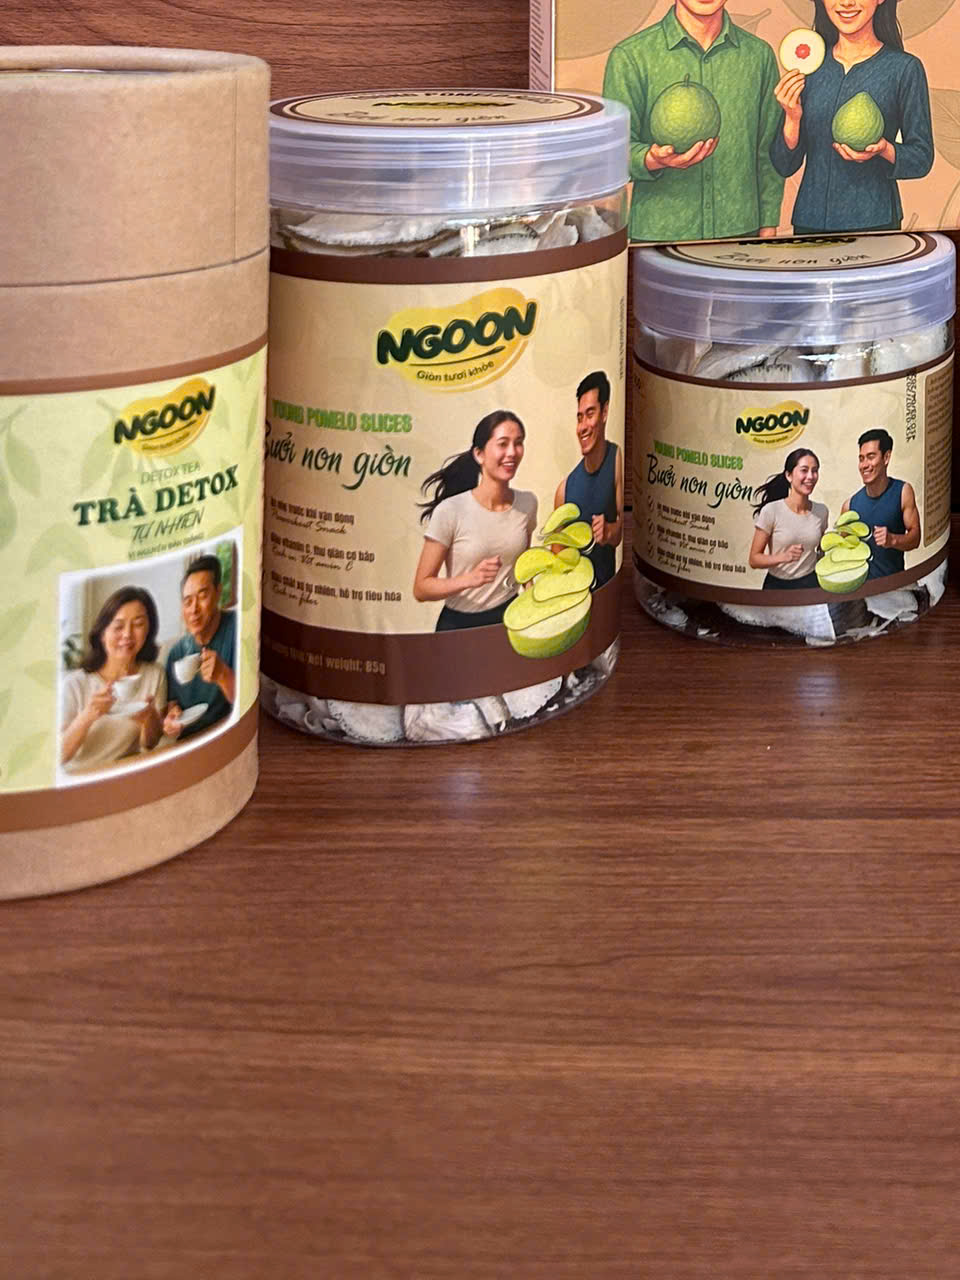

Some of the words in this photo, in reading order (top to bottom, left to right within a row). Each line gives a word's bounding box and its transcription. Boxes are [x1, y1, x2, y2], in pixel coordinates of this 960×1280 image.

[377, 301, 537, 364] NGOON
[416, 370, 442, 382] Giòn
[444, 369, 467, 381] tươi
[114, 384, 216, 444] NGOON
[306, 407, 357, 431] POMELO
[360, 413, 413, 433] SLICES
[736, 408, 810, 434] NGOON
[140, 465, 180, 485] DETOX
[181, 461, 201, 475] TEA
[302, 447, 343, 474] non
[341, 444, 412, 490] giòn
[647, 453, 676, 488] Bưởi
[680, 476, 708, 496] non
[707, 477, 753, 509] giòn
[710, 454, 743, 471] SLICES
[73, 486, 146, 526] TRÀ
[155, 463, 239, 513] DETOX
[131, 520, 155, 544] TỰ
[154, 506, 205, 537] NHIÊN
